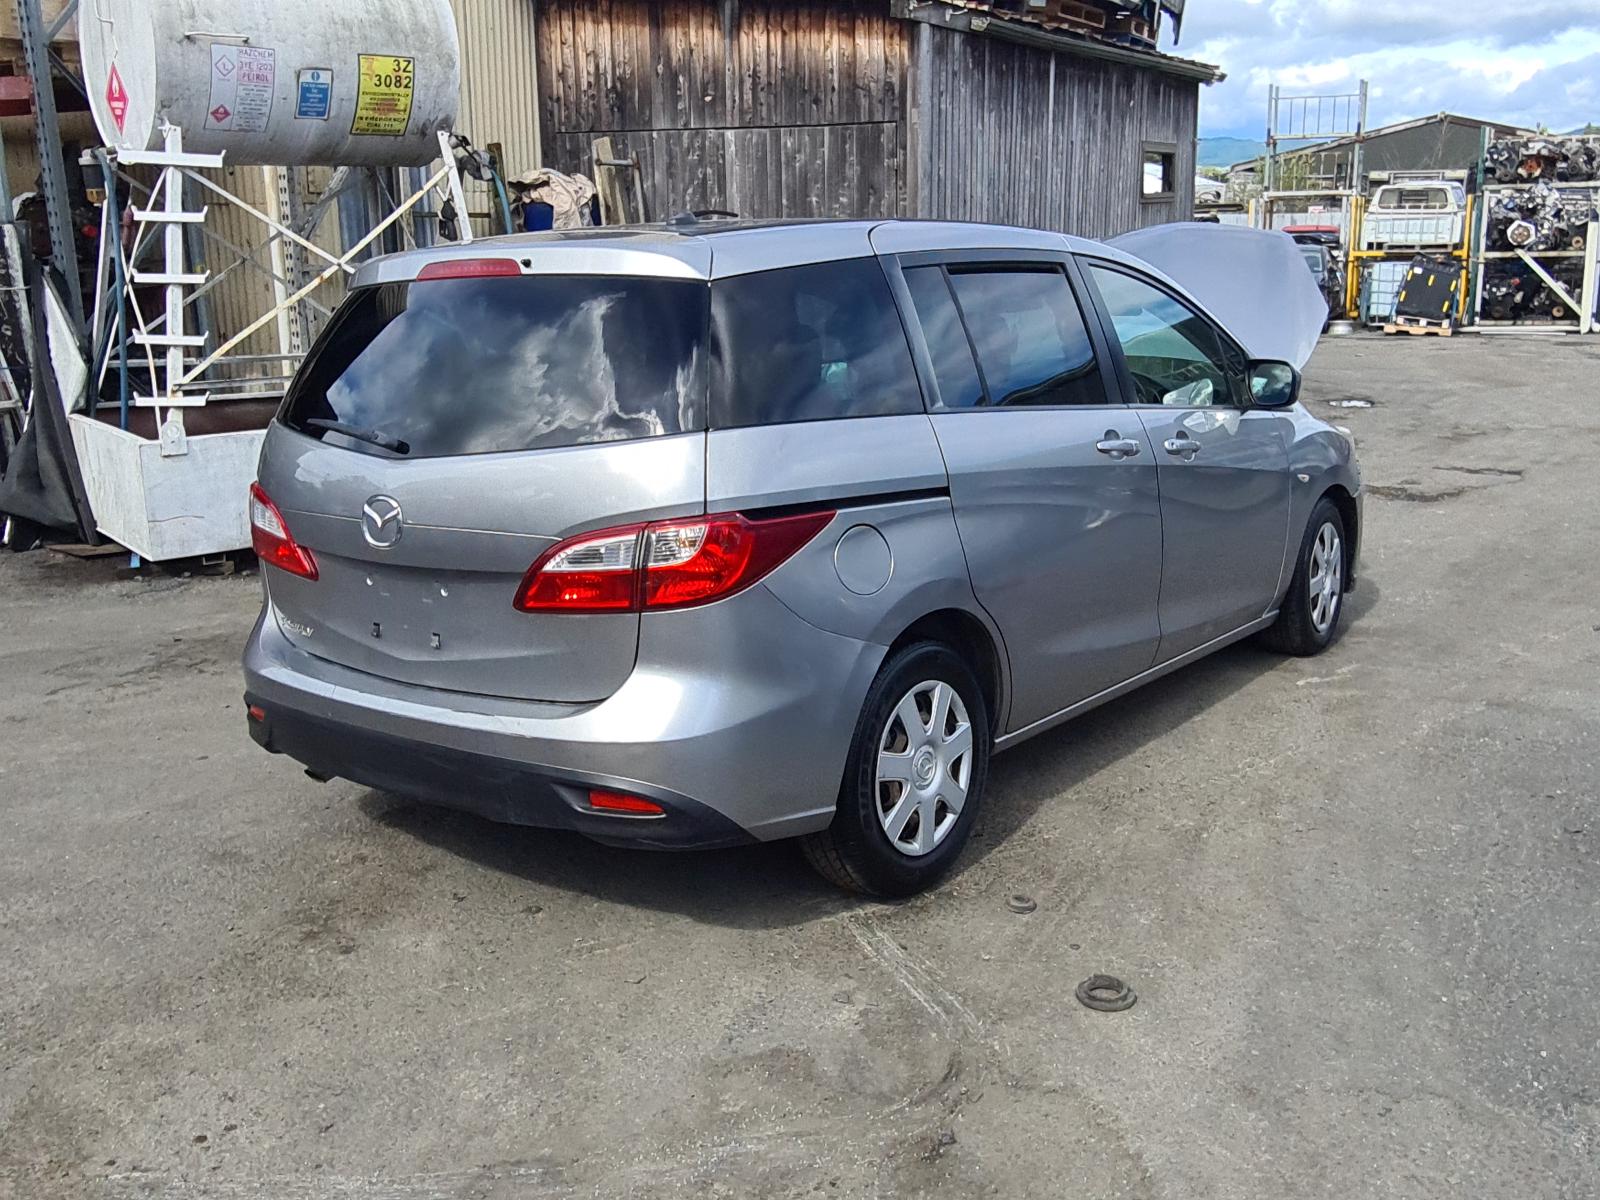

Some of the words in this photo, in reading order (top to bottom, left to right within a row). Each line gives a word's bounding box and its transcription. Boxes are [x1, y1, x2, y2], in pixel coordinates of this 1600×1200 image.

[256, 62, 273, 72] 1203
[393, 59, 412, 73] 3Z
[242, 71, 270, 82] PETROL
[374, 74, 412, 89] 3082
